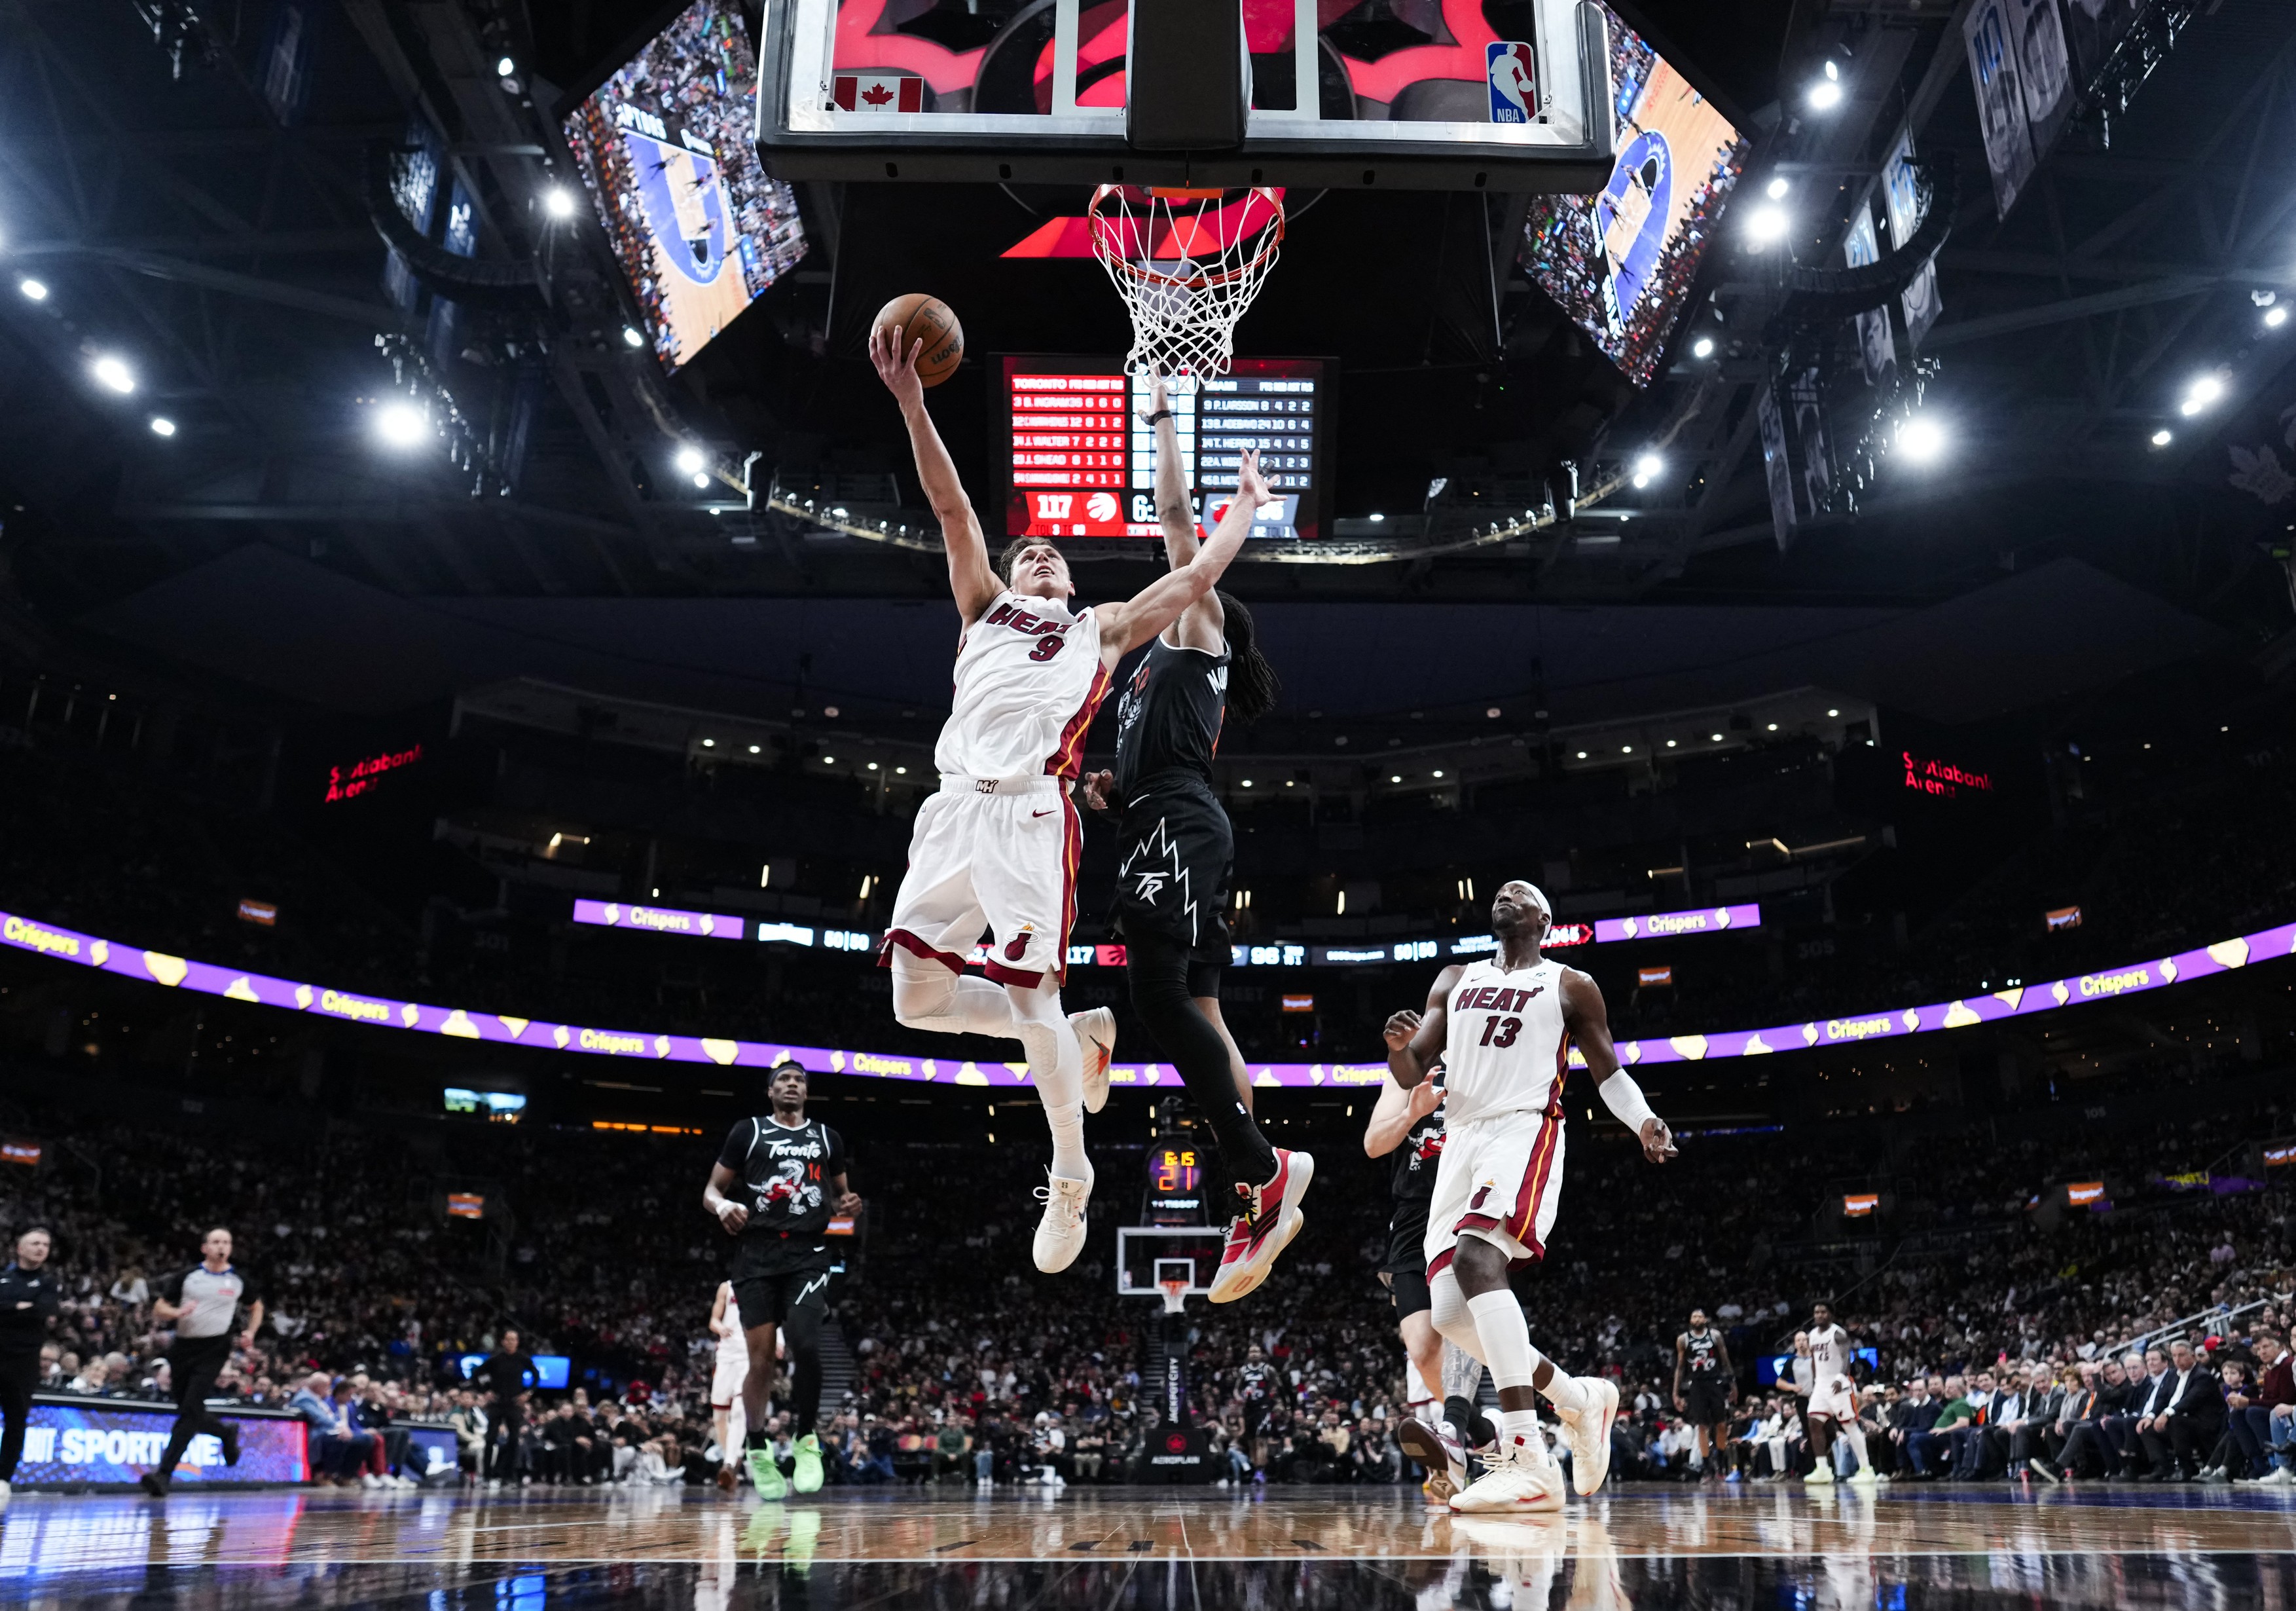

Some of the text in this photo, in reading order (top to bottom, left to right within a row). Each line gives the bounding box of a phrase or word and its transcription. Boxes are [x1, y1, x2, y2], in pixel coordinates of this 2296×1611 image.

[1497, 108, 1520, 122] NBA
[931, 334, 963, 365] ilson
[1013, 379, 1067, 390] TORONTO
[1013, 397, 1022, 407] 3
[1112, 398, 1121, 408] 0
[1203, 400, 1212, 411] 9
[1260, 400, 1269, 411] 8
[1274, 401, 1283, 411] 4
[1288, 401, 1297, 411] 2
[1302, 401, 1310, 412] 2
[1070, 417, 1082, 427] 12
[1100, 417, 1107, 428] 1
[1113, 417, 1121, 428] 2
[1201, 418, 1214, 430] 13
[1258, 419, 1271, 430] 24
[1272, 419, 1285, 430] 10
[1287, 419, 1296, 430] 6
[1301, 420, 1309, 430] 4
[1072, 436, 1080, 447] 7
[1085, 436, 1094, 447] 2
[1099, 436, 1108, 447] 2
[1113, 436, 1121, 447] 2
[1222, 437, 1256, 449] HERRO
[1257, 438, 1271, 449] 15
[1273, 439, 1282, 449] 4
[1287, 439, 1296, 449] 4
[1300, 439, 1309, 450] 5
[1086, 454, 1093, 466] 1
[1100, 454, 1107, 466] 1
[1113, 454, 1121, 466] 0
[1286, 457, 1295, 468] 2
[1300, 457, 1309, 468] 3
[1072, 473, 1081, 484] 2
[1085, 473, 1095, 484] 4
[1100, 473, 1107, 485] 1
[1114, 473, 1121, 485] 1
[1285, 476, 1296, 487] 11
[1299, 476, 1308, 487] 2
[1037, 494, 1073, 519] 117
[1284, 526, 1291, 538] 1
[1029, 635, 1065, 661] 9
[329, 744, 420, 785] Stiaban
[325, 777, 378, 802] Aren
[630, 906, 690, 931] Crispers
[1647, 915, 1707, 934] Crispers
[3, 916, 79, 956] Crispers
[1251, 947, 1279, 965] 96
[2079, 969, 2150, 995] Crispers
[321, 990, 390, 1020] Crispers
[1455, 986, 1544, 1012] HEAT
[1479, 1016, 1522, 1048] 13
[1827, 1018, 1891, 1040] Crispers
[579, 1029, 645, 1054] Crispers
[853, 1053, 912, 1077] Crispers
[1332, 1065, 1389, 1086] Crispers
[764, 1138, 821, 1160] Toronto
[1165, 1151, 1195, 1166] 6:15
[808, 1162, 821, 1182] 14
[1159, 1166, 1192, 1191] 21
[23, 1427, 227, 1467] BUT SPORTNE
[1152, 1455, 1201, 1464] AEROPLAN
